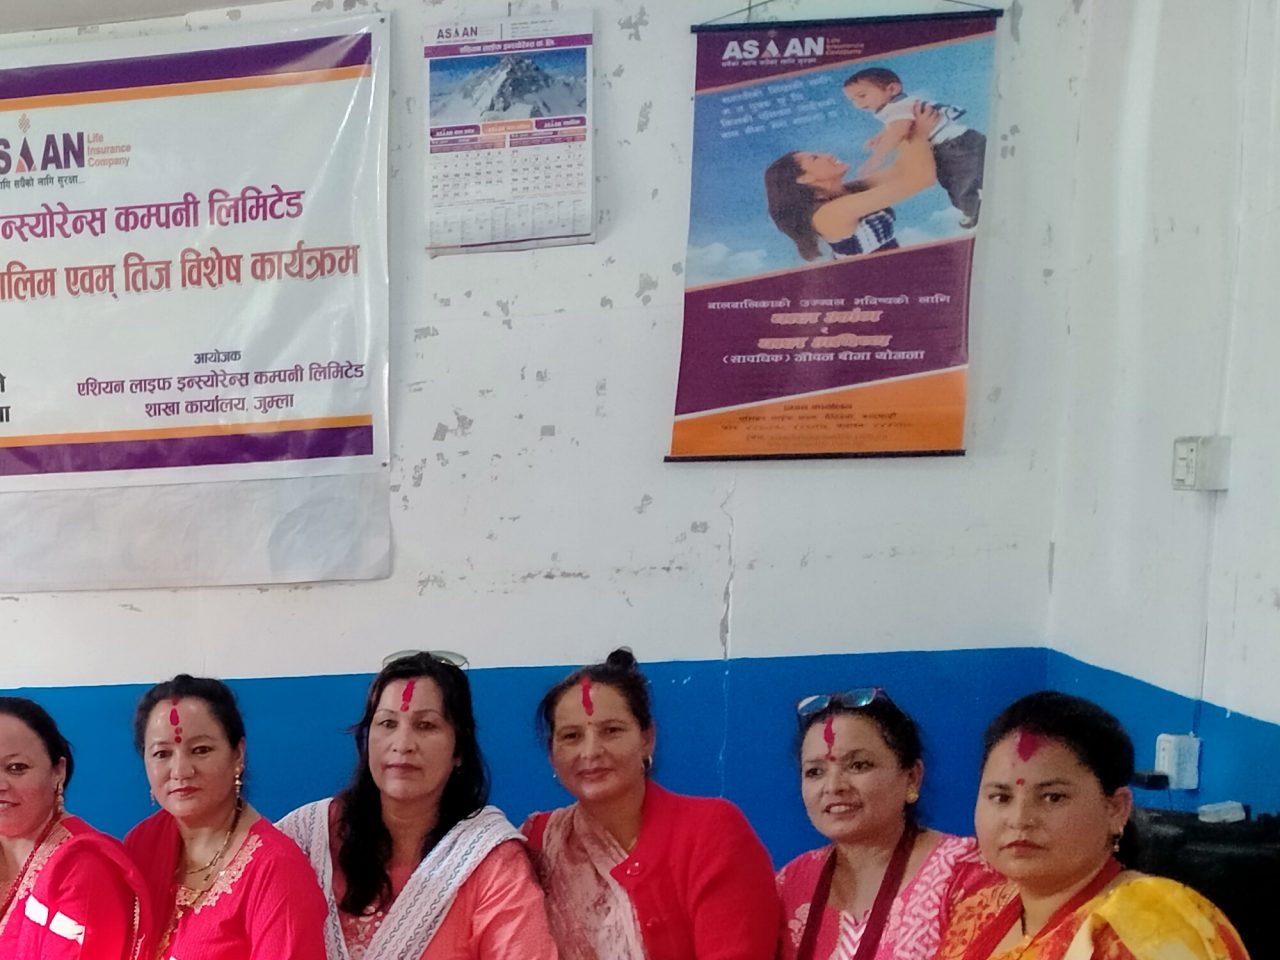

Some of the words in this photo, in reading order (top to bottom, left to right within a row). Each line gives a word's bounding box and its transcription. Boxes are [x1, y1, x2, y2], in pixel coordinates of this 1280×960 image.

[721, 36, 825, 60] ASIAN
[87, 132, 104, 144] Life
[87, 143, 132, 156] Insurance
[87, 155, 130, 168] Company
[114, 191, 201, 233] कम्पनी
[208, 184, 306, 227] लिमिटेड
[63, 263, 119, 299] एवम्
[124, 251, 172, 294] तिज
[180, 246, 244, 289] विशेष
[250, 239, 361, 282] कार्यक्रम
[193, 349, 242, 365] आयोजक
[76, 377, 126, 397] एशियन
[129, 375, 172, 394] लाइफ
[176, 369, 250, 393] इन्स्योरेन्स
[254, 364, 304, 385] कम्पनी
[308, 359, 366, 382] लिमिटेड
[144, 401, 181, 418] शाखा
[253, 393, 295, 415] जुम्ला
